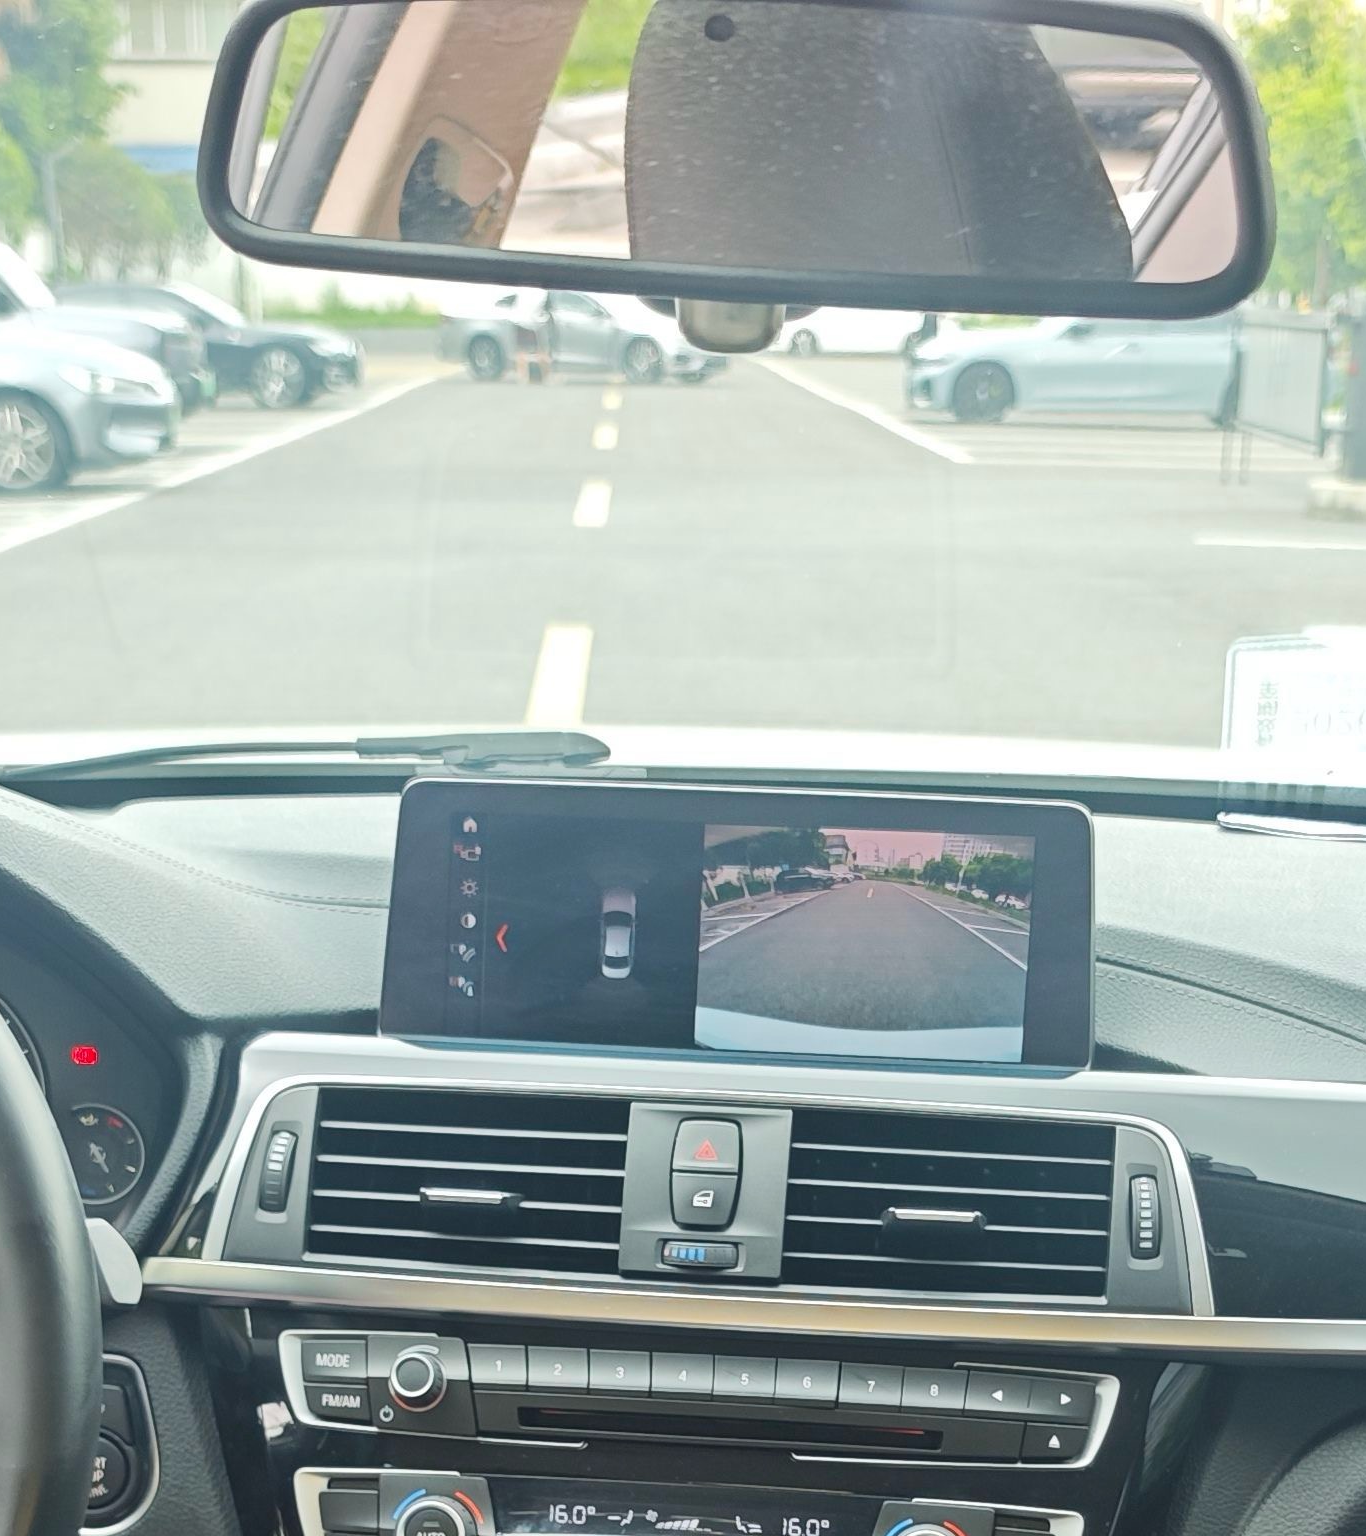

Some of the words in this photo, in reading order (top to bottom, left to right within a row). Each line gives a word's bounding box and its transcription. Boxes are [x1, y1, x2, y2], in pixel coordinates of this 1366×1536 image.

[316, 1353, 350, 1368] MODE
[495, 1359, 503, 1372] 1
[553, 1363, 563, 1376] 2
[615, 1366, 625, 1379] 3
[678, 1370, 687, 1382] 4
[740, 1373, 749, 1386] 5
[802, 1376, 812, 1389] 6
[867, 1380, 876, 1393] 7
[929, 1384, 939, 1397] 8
[322, 1393, 361, 1409] FM/AM
